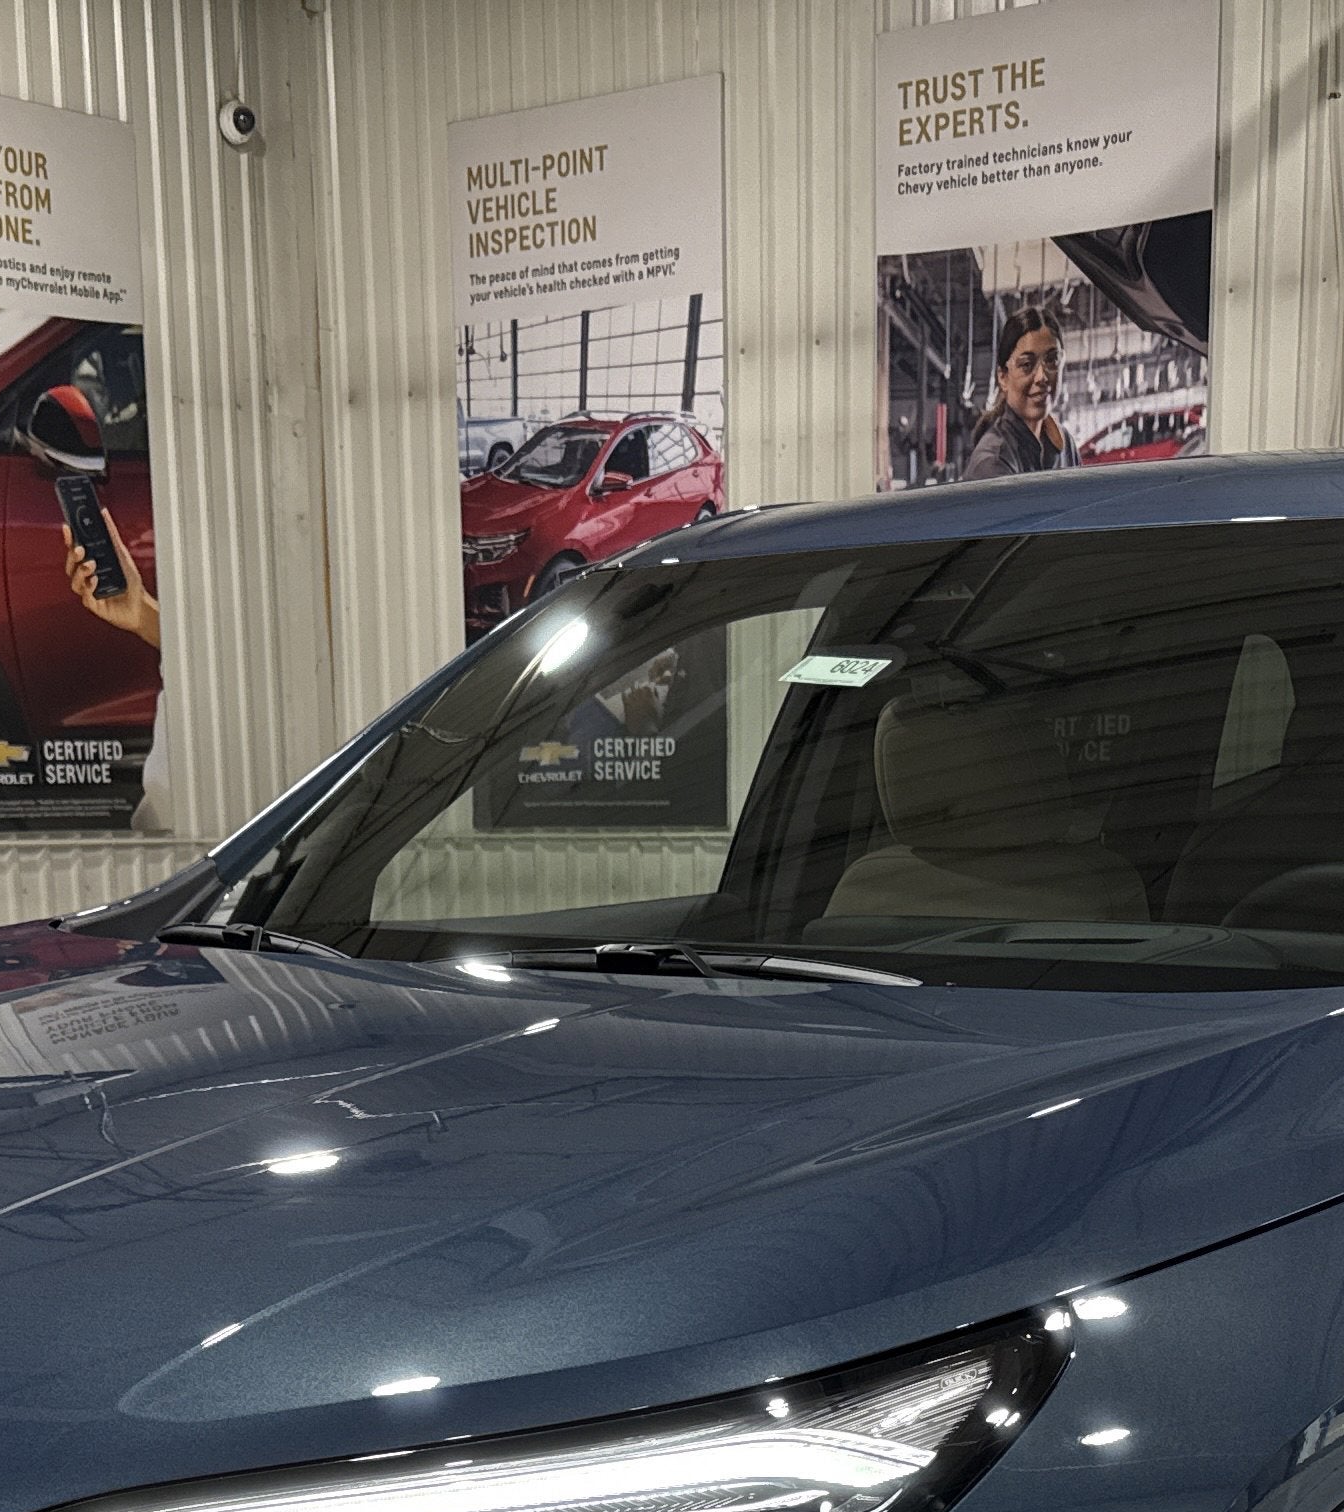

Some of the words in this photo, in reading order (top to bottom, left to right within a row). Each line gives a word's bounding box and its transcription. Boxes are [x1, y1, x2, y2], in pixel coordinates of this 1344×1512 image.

[898, 68, 984, 110] TRUST
[992, 57, 1045, 94] THE
[899, 100, 1029, 147] EXPERTS.
[467, 145, 608, 192] MULTI-POINT
[898, 160, 943, 178] Factory
[946, 152, 989, 171] trained
[992, 141, 1063, 164] technicians
[1066, 136, 1100, 152] know
[1103, 130, 1133, 150] your
[898, 178, 933, 195] Chevy
[936, 173, 978, 191] vehicle
[981, 168, 1020, 185] better
[1023, 163, 1050, 178] than
[1054, 156, 1103, 176] anyone.
[467, 188, 557, 225] VEHICLE
[469, 215, 597, 258] INSPECTION
[29, 262, 47, 276] and
[50, 267, 74, 283] enjoy
[77, 270, 112, 284] remote
[470, 273, 486, 286] The
[489, 270, 516, 287] peace
[519, 266, 529, 279] of
[531, 263, 555, 278] mind
[558, 261, 578, 273] that
[581, 257, 612, 271] comes
[615, 251, 639, 266] from
[642, 246, 680, 265] getting
[6, 277, 67, 296] myChevrolet
[70, 285, 100, 300] Mobile
[470, 290, 491, 306] your
[494, 284, 534, 299] vehicle's
[536, 280, 567, 294] health
[569, 274, 610, 290] checked
[613, 270, 635, 284] with
[43, 740, 123, 761] CERTIFIED
[594, 737, 676, 758] CERTIFIED
[45, 764, 112, 784] SERVICE
[518, 770, 582, 783] CHEVROLET
[594, 760, 661, 781] SERVICE
